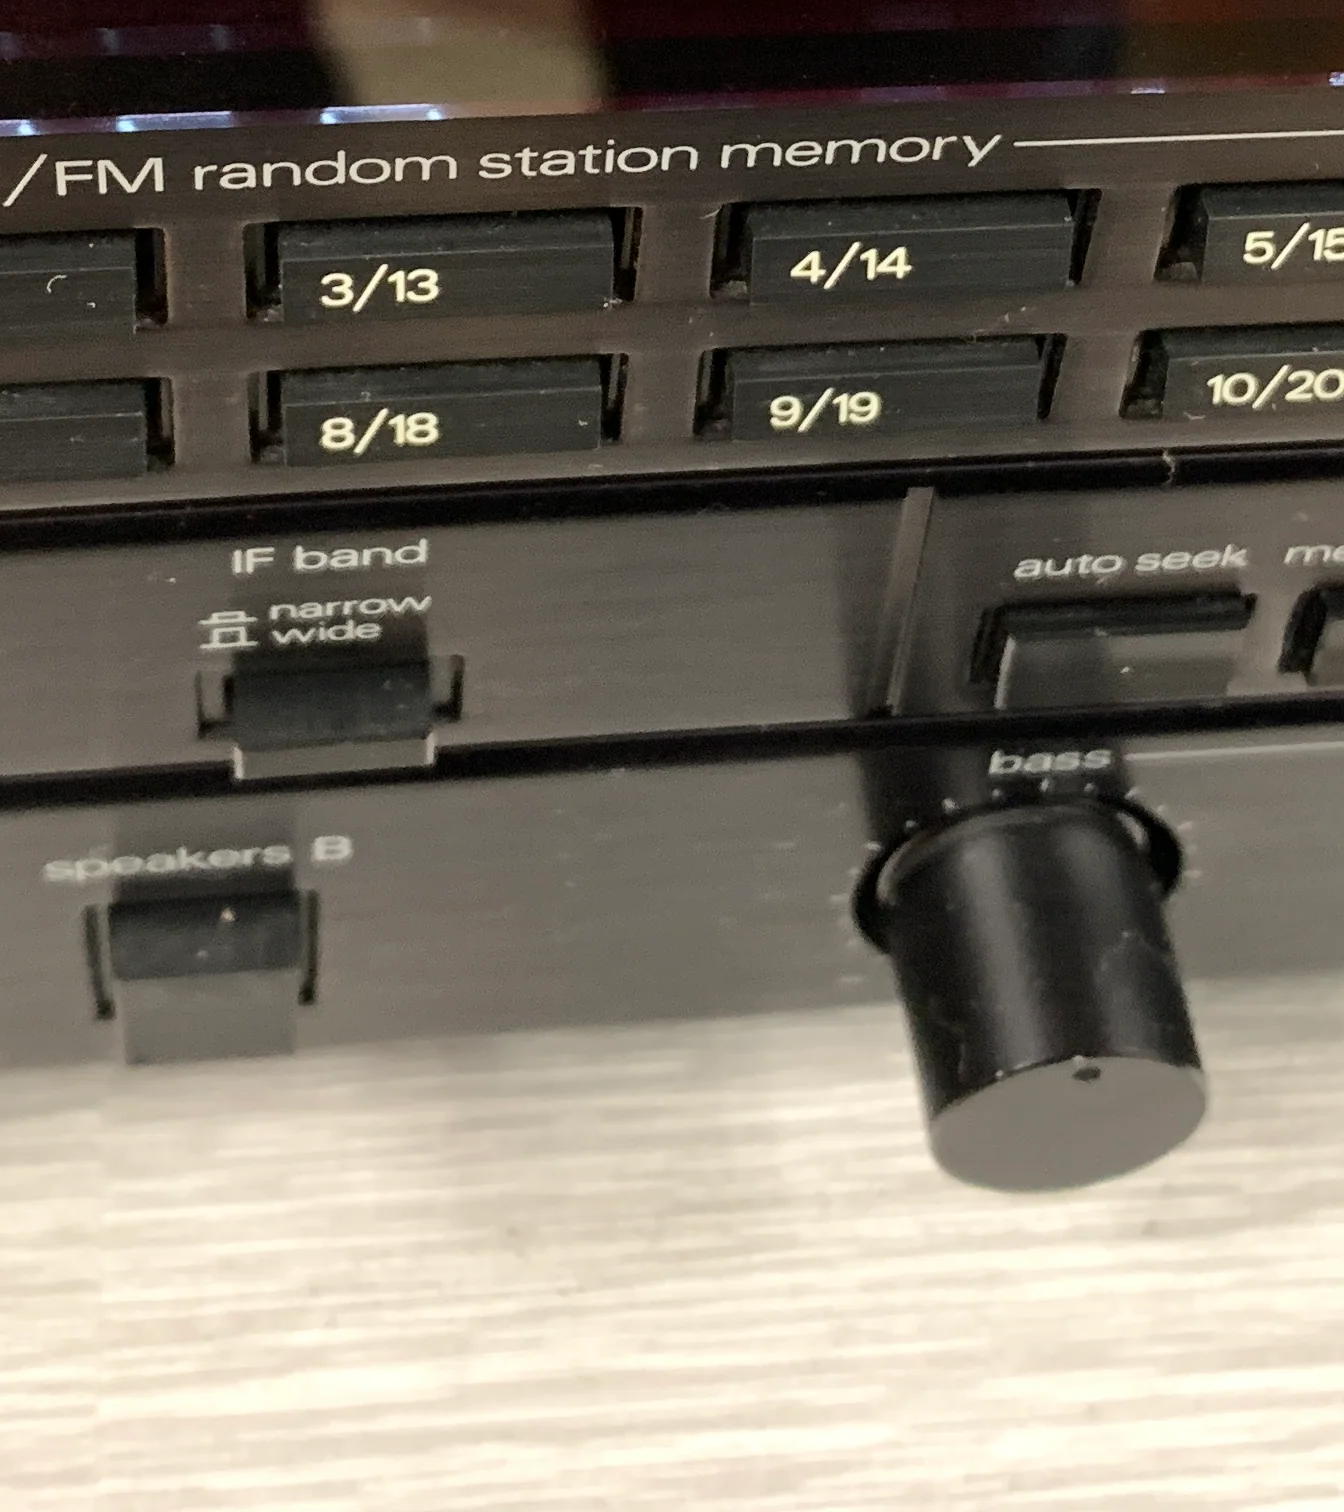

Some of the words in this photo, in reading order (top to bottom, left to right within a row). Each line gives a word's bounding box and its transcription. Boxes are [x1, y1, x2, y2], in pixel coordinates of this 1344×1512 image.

[192, 148, 456, 191] random
[477, 139, 698, 181] station
[720, 132, 1002, 169] memory
[789, 241, 911, 288] 4/14
[319, 263, 441, 312] 3/13
[319, 408, 441, 456] 8/18
[768, 388, 881, 432] 9/19
[231, 547, 275, 574] IF
[293, 539, 428, 572] band
[1013, 550, 1123, 579] auto
[1136, 543, 1247, 574] seek
[269, 591, 432, 622] narrow
[271, 619, 381, 644] wide
[988, 747, 1112, 775] bass
[44, 842, 292, 883] speakers
[312, 836, 353, 863] B
